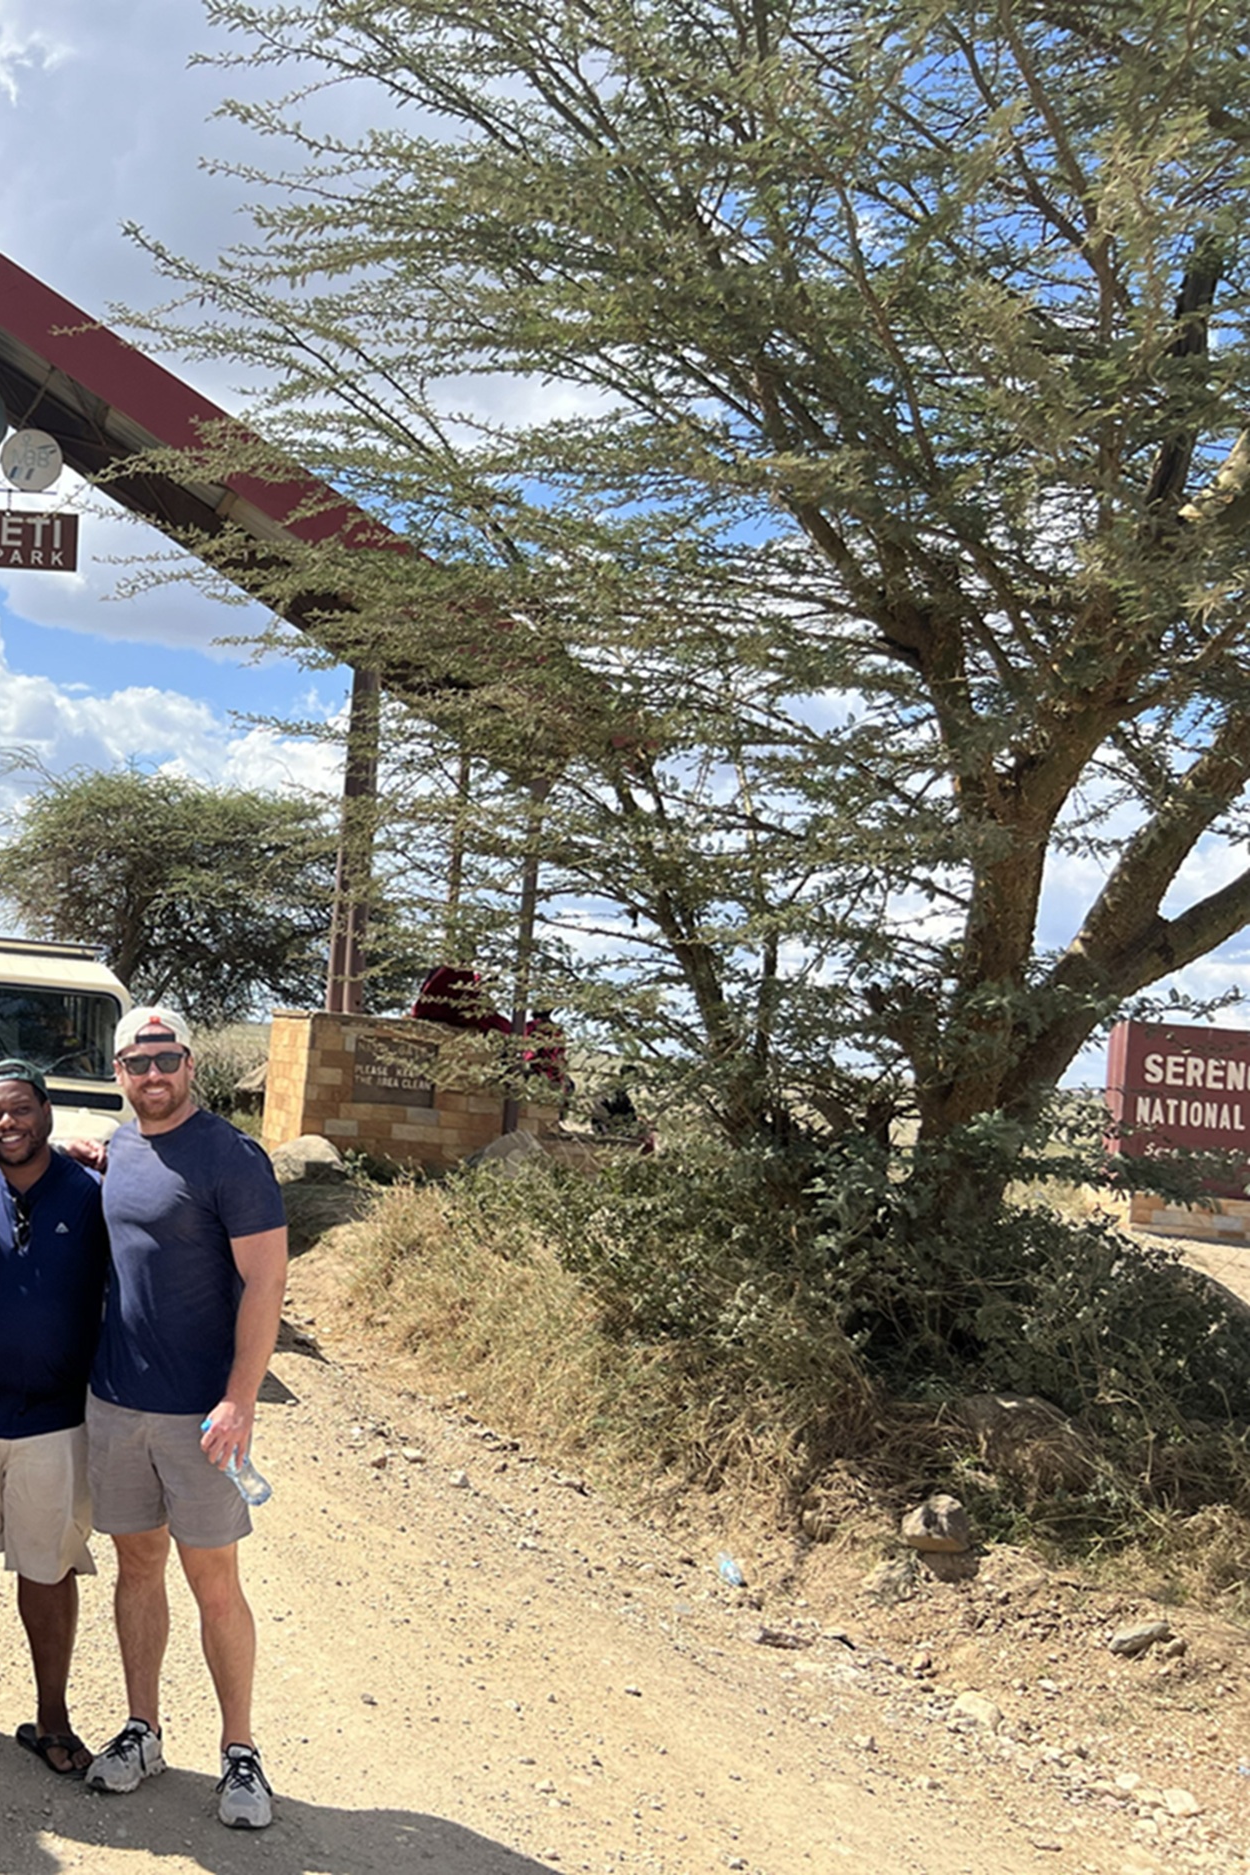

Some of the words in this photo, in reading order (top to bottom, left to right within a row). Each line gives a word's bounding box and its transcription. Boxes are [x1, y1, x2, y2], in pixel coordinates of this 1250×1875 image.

[354, 1064, 389, 1077] PLEASE
[354, 1074, 373, 1086] THE
[376, 1077, 399, 1088] AREA
[401, 1078, 431, 1091] CLEAN
[1144, 1053, 1250, 1091] SEREN
[1136, 1096, 1246, 1131] NATIONAL
